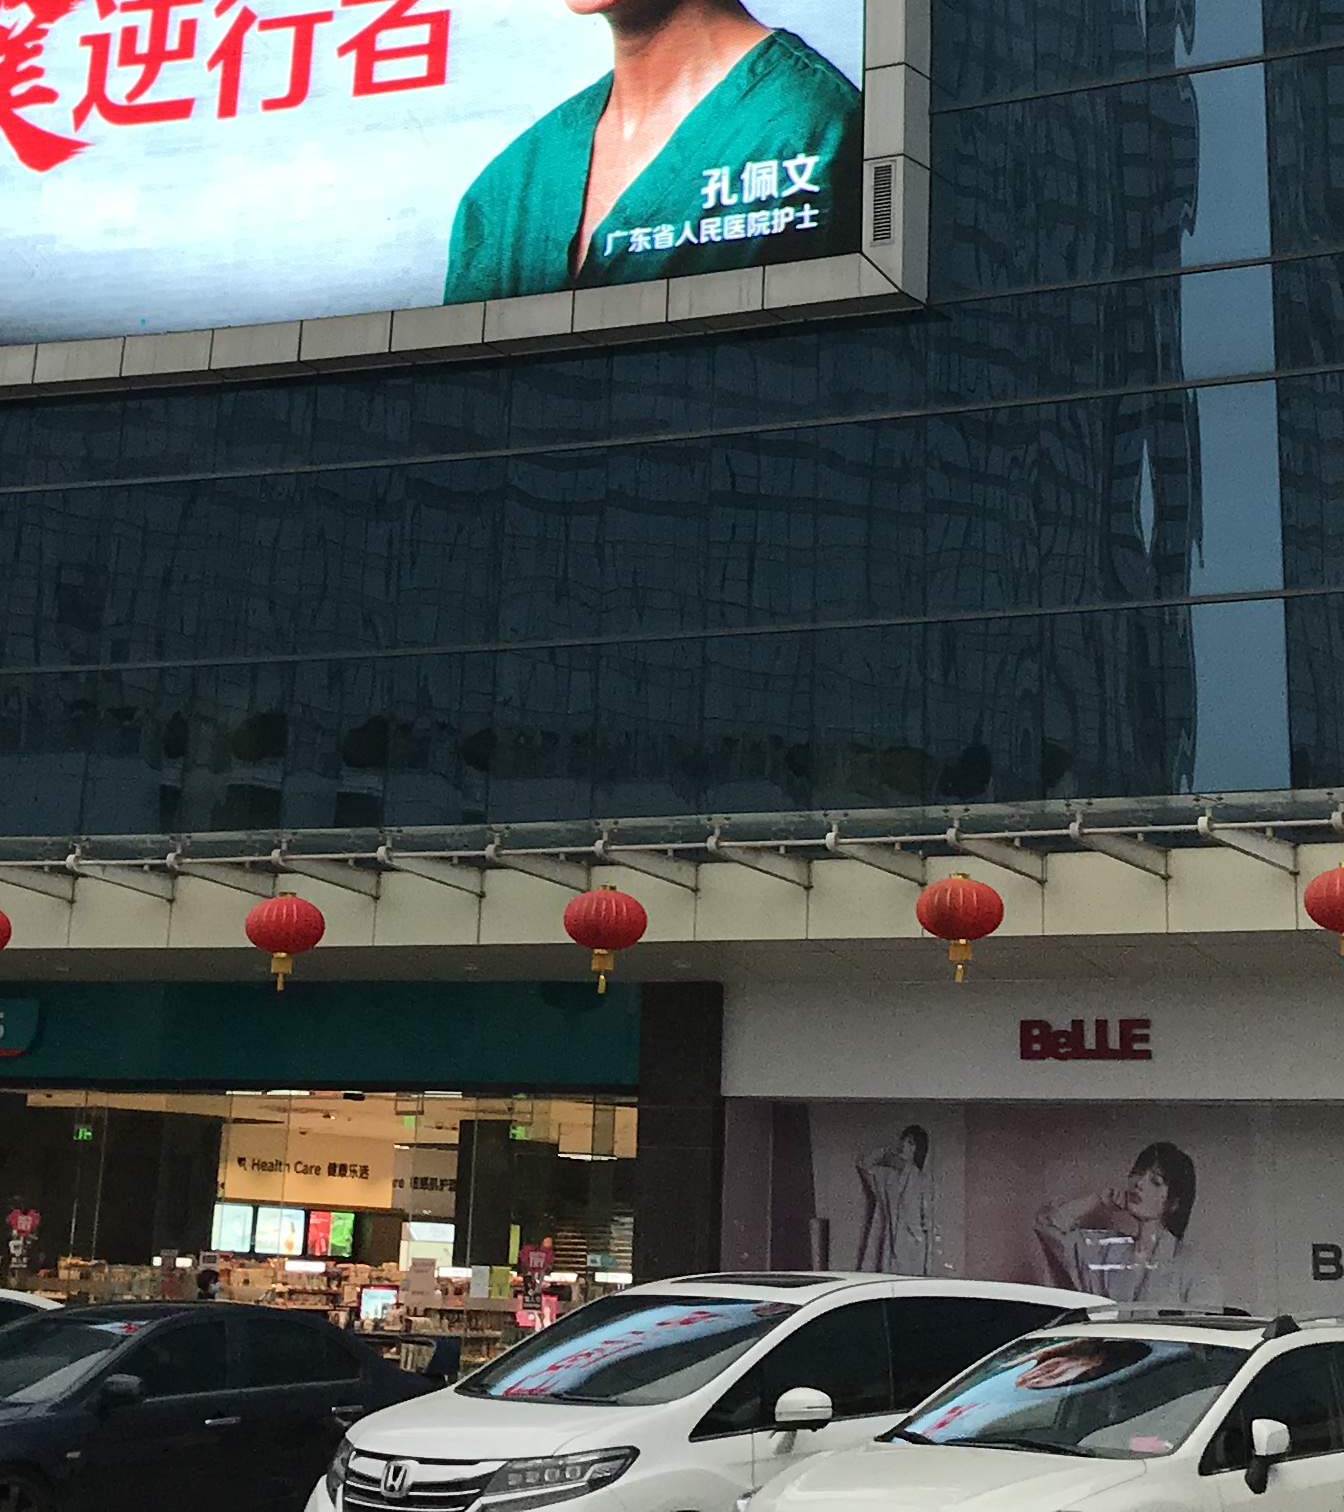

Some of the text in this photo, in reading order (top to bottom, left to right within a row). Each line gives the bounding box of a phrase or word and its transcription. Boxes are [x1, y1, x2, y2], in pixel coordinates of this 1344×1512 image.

[700, 153, 821, 211] 孔佩文
[603, 203, 819, 257] 广东省人民医院护士
[251, 1158, 290, 1174] Health
[294, 1161, 322, 1176] Care
